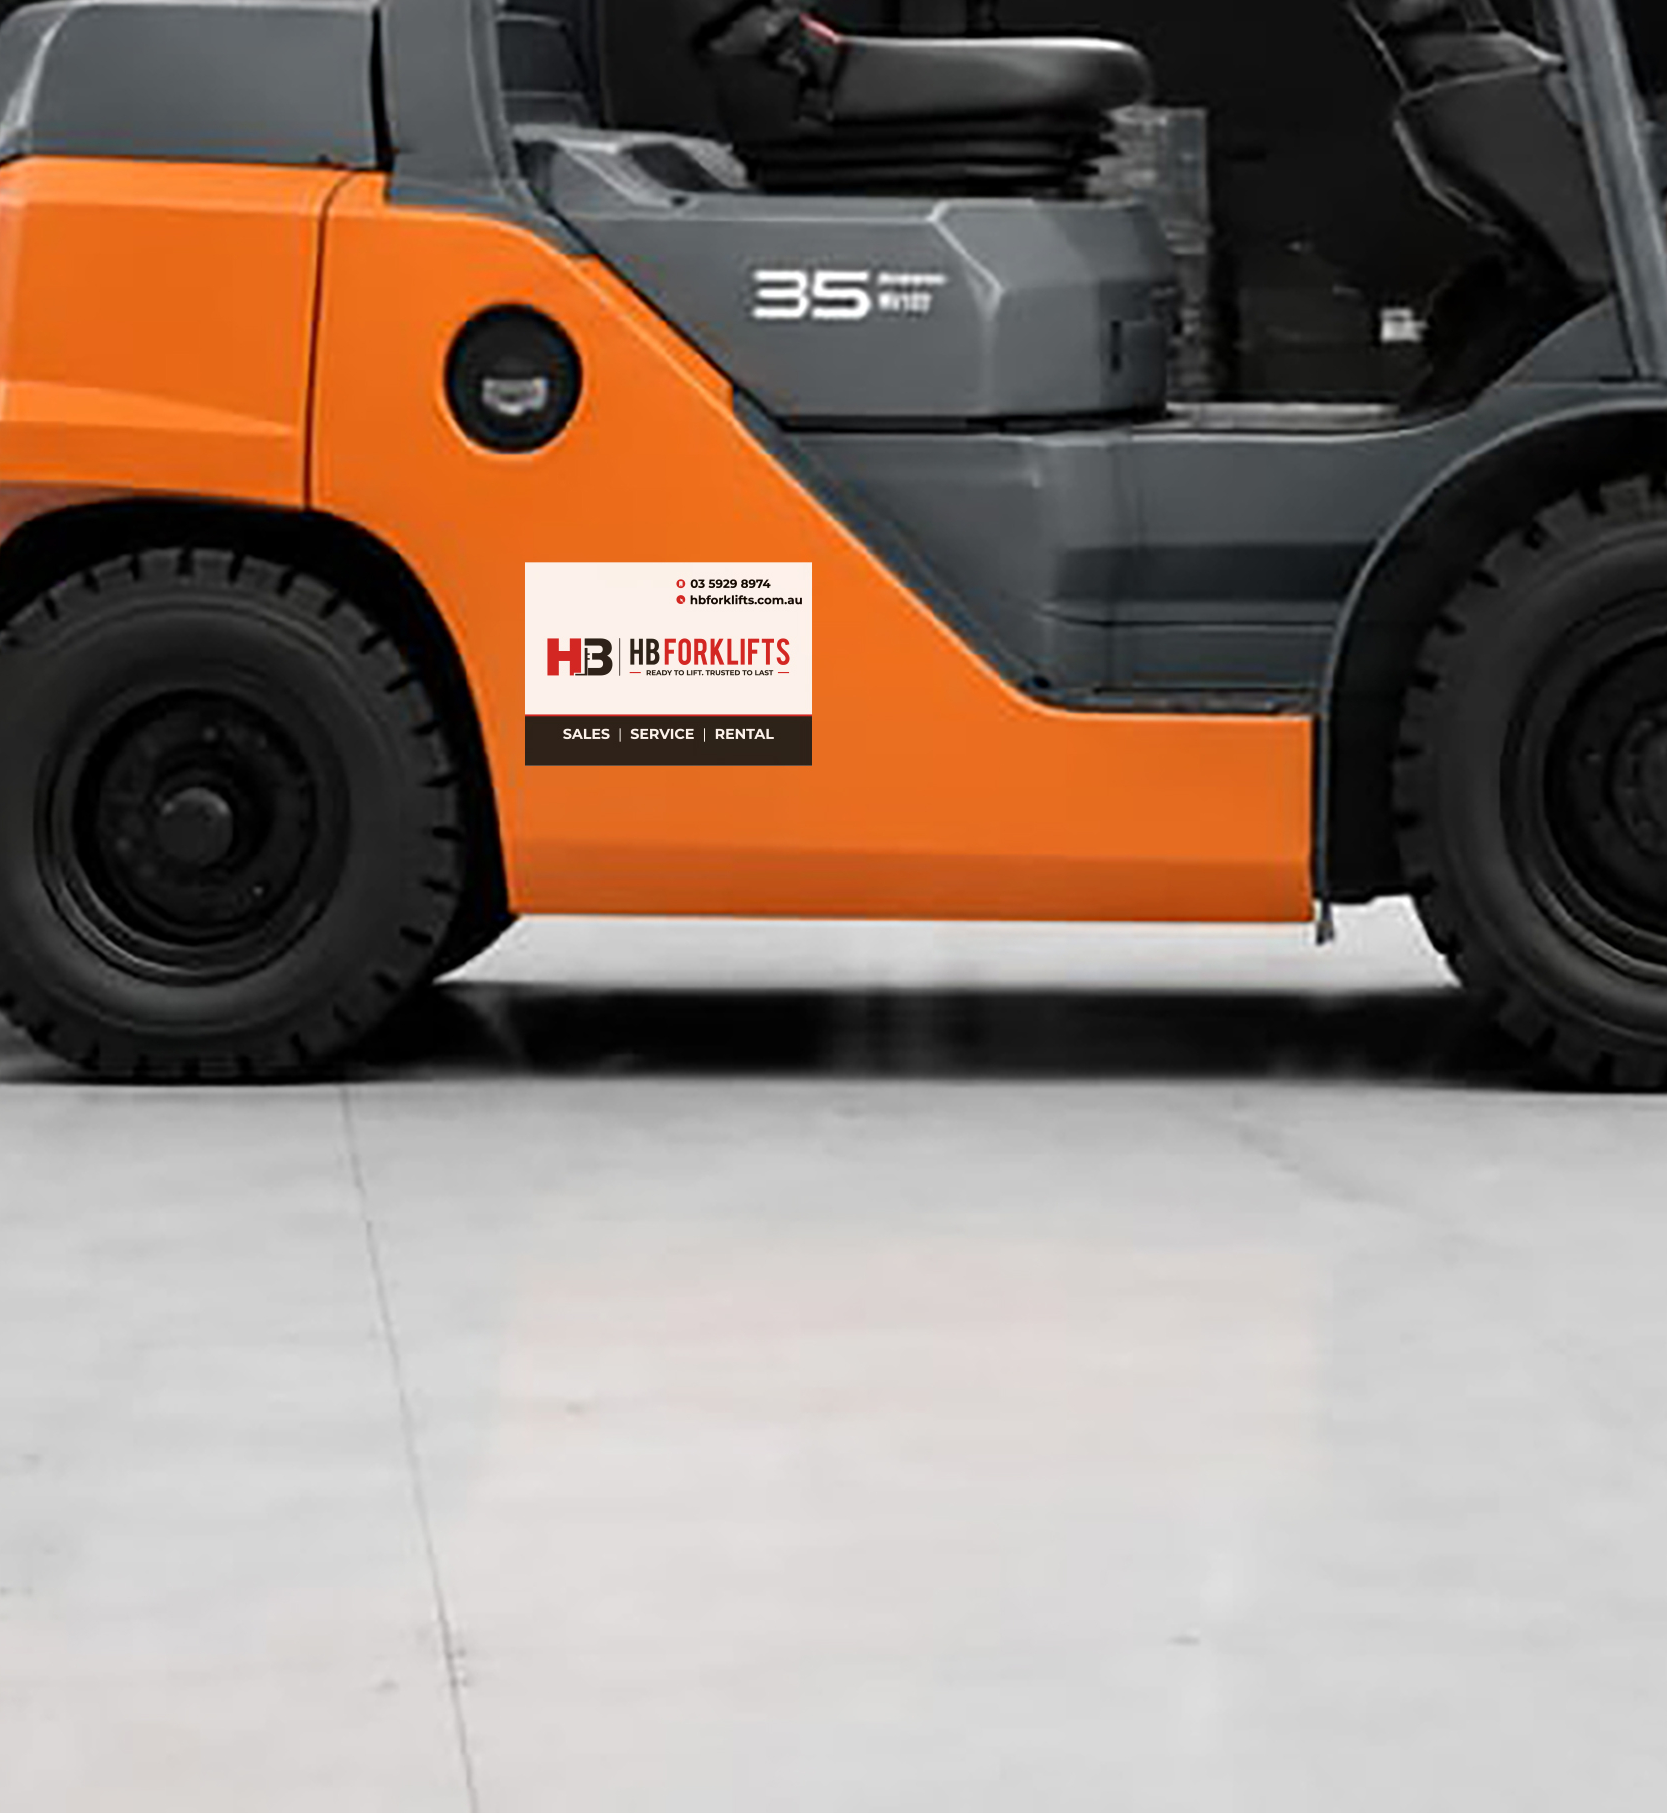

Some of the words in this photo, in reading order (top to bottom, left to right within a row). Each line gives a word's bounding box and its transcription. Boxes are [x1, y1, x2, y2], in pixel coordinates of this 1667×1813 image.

[752, 270, 872, 319] 35
[690, 578, 706, 589] 03
[708, 578, 738, 589] 5929
[740, 578, 771, 589] 8974
[690, 594, 803, 605] hbforklifts.com.au
[562, 728, 610, 740] SALES
[630, 728, 694, 740] SERVICE
[715, 728, 774, 740] RENTAL
